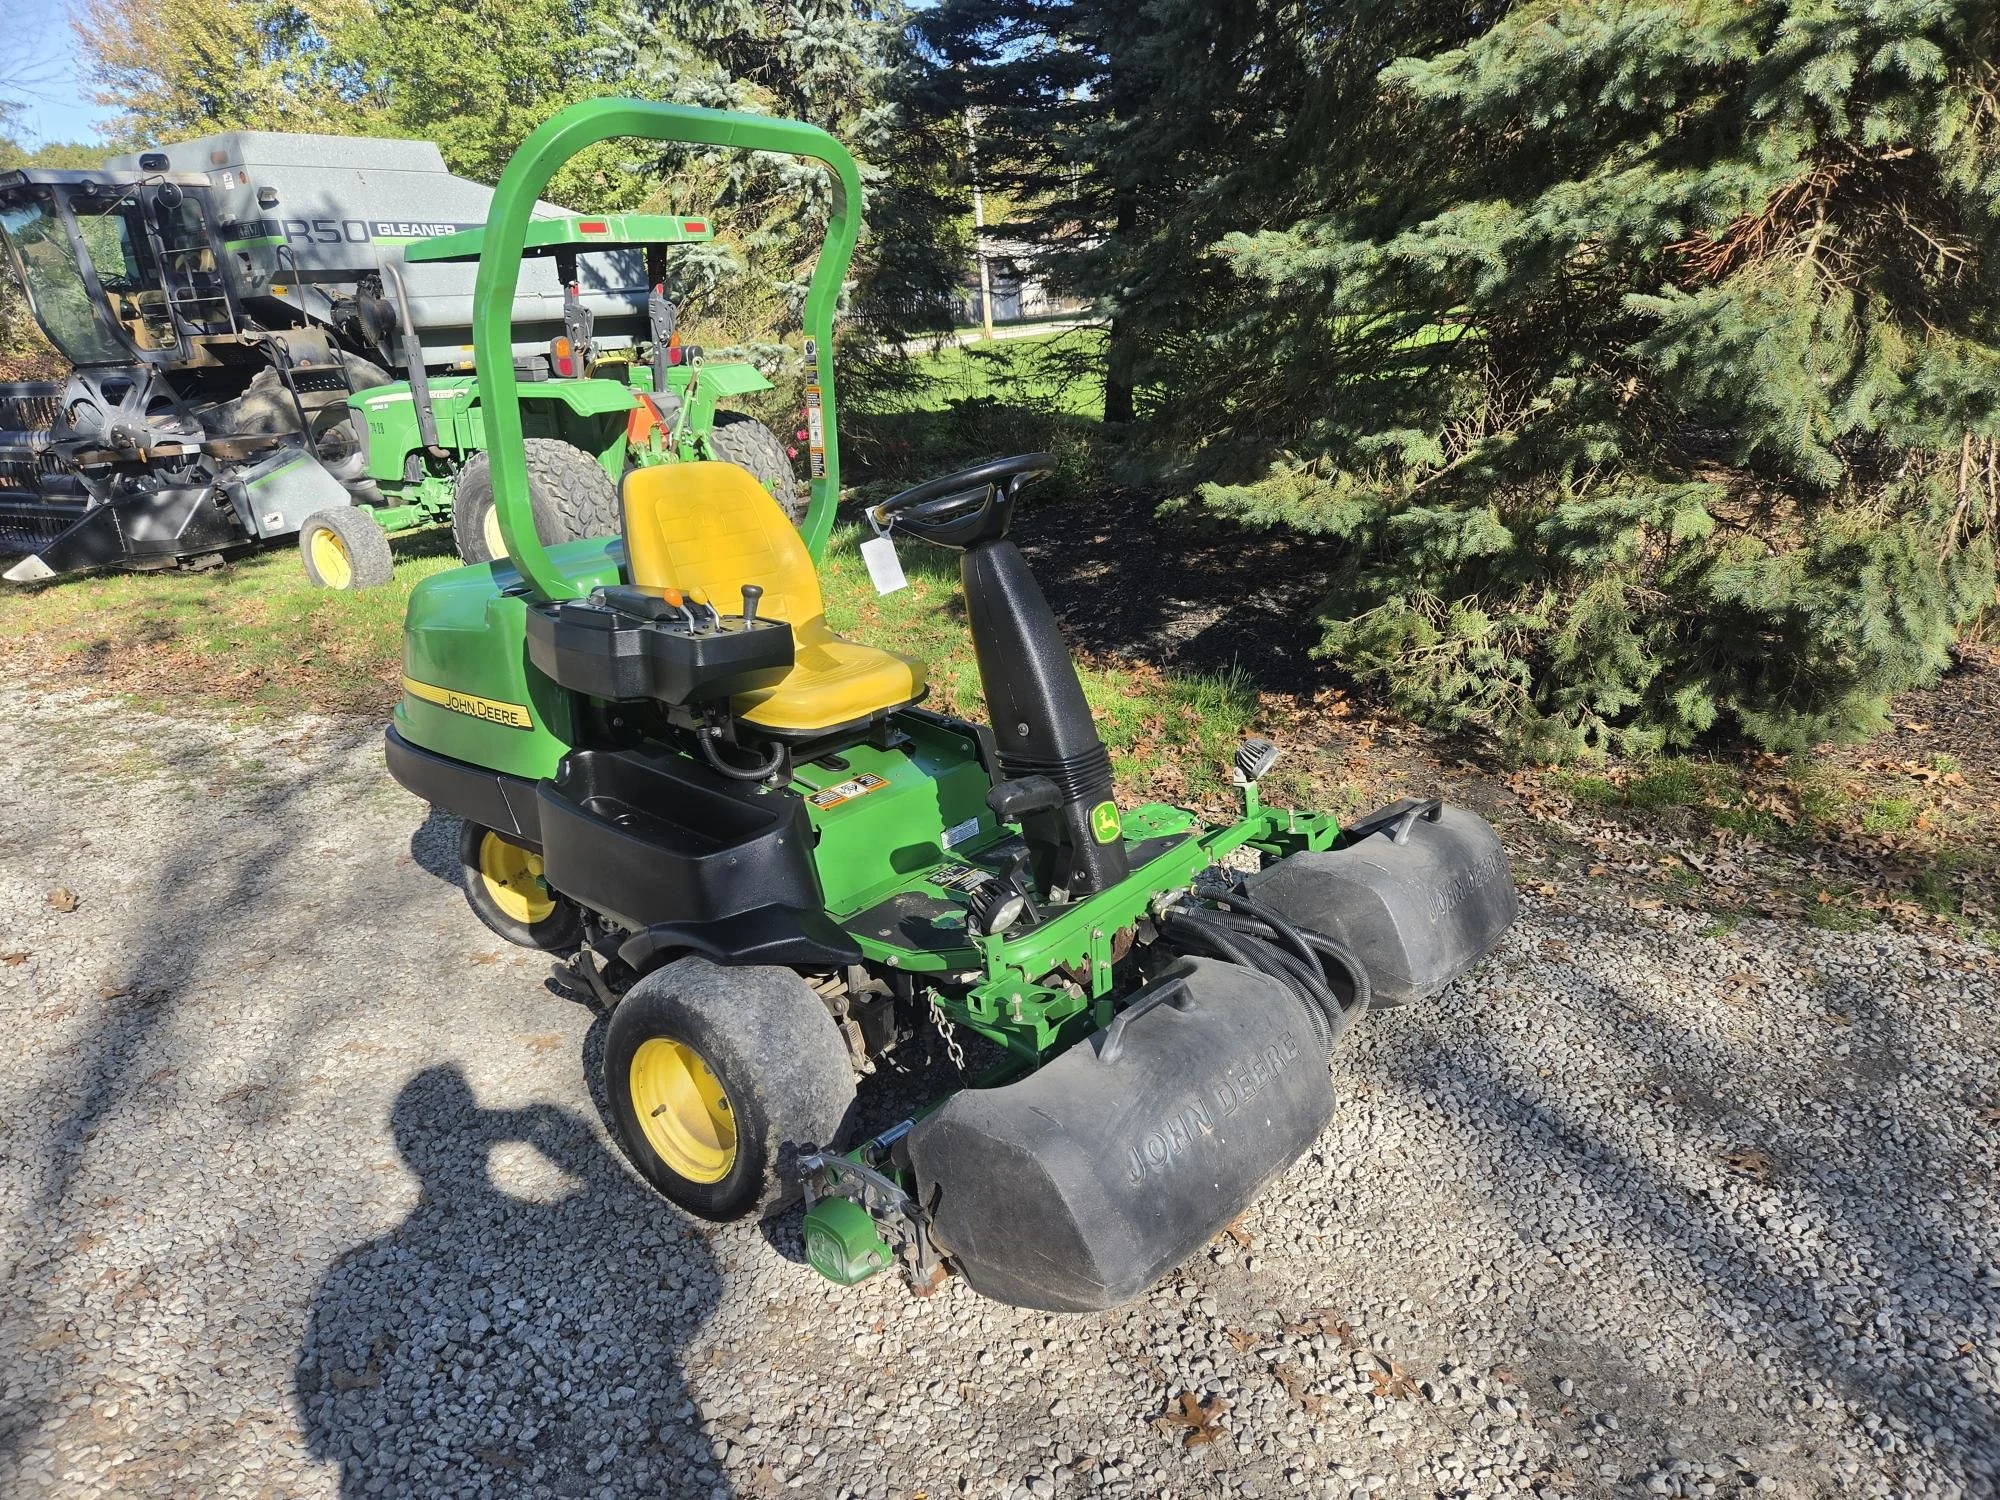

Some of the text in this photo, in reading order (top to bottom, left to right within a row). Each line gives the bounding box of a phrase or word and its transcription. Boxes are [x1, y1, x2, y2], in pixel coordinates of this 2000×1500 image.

[284, 219, 371, 244] R50
[377, 222, 456, 237] GLEANER
[445, 693, 519, 725] JOHN DEERE
[1128, 1031, 1302, 1184] JOHN DEERE
